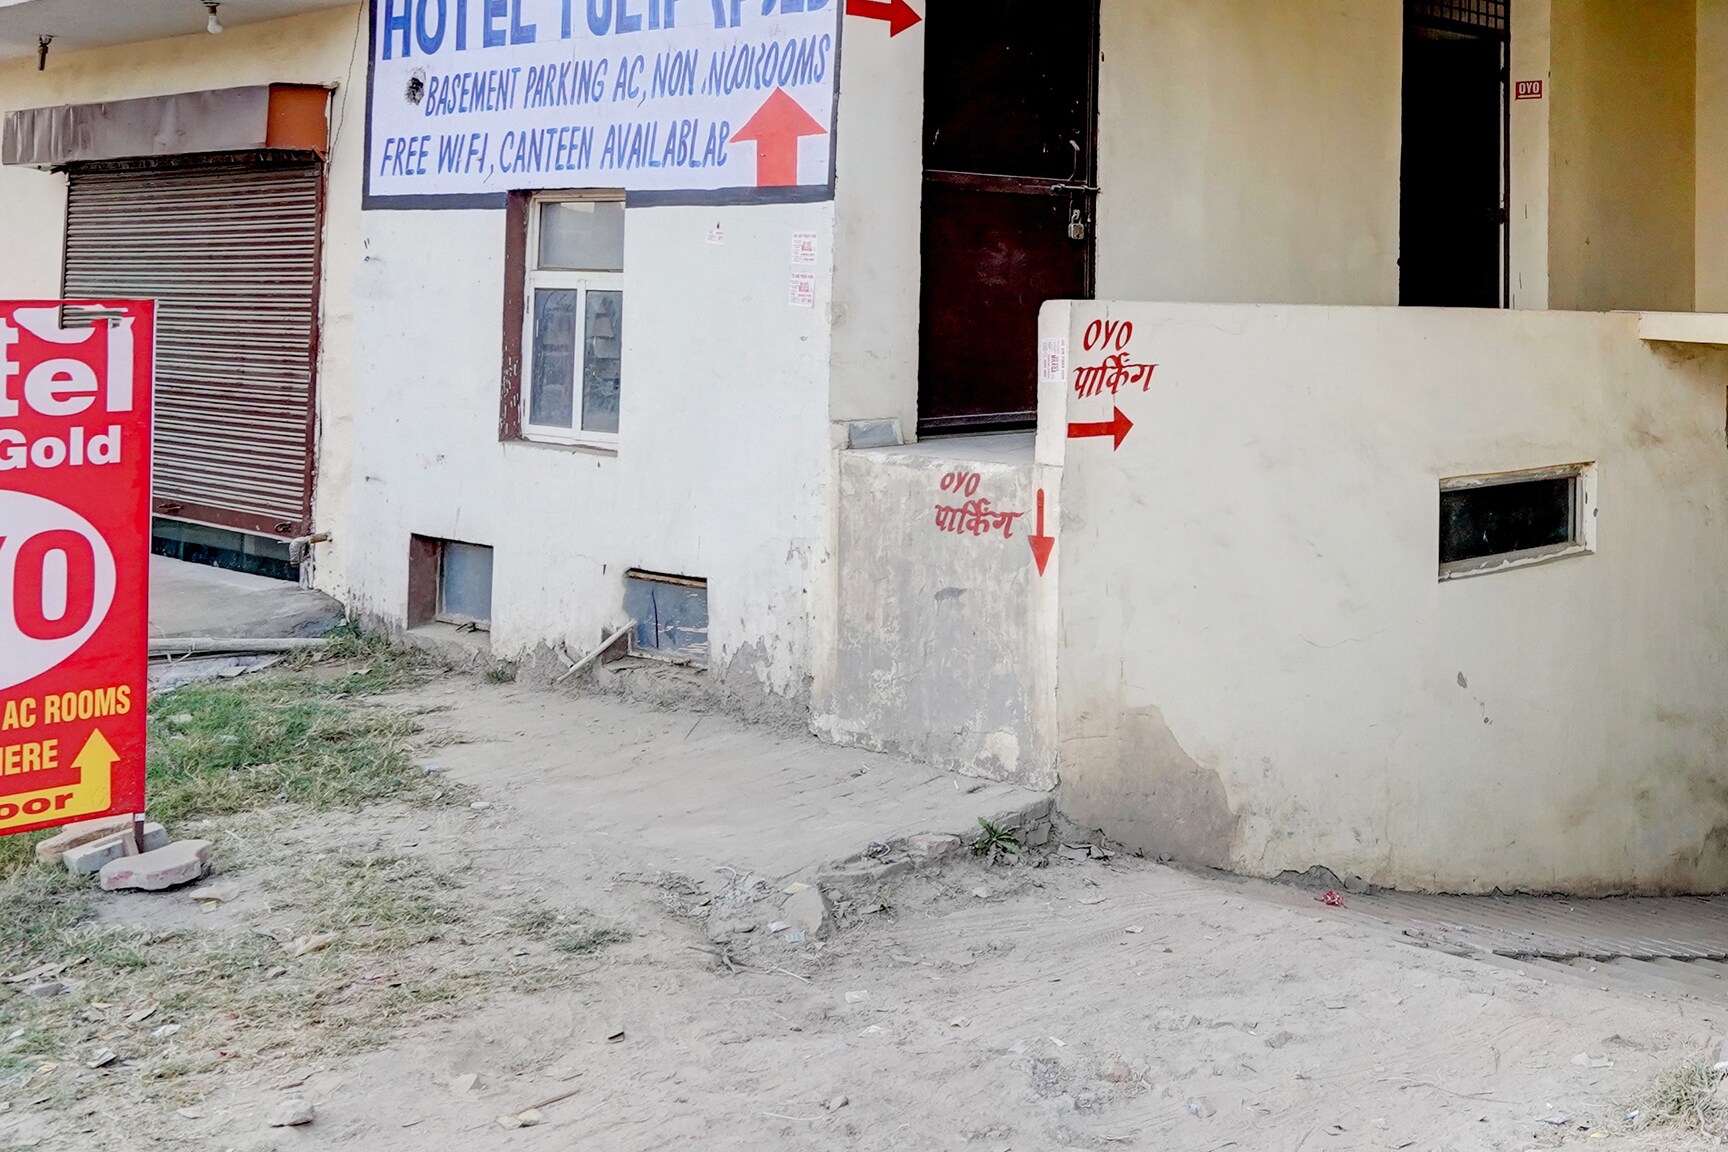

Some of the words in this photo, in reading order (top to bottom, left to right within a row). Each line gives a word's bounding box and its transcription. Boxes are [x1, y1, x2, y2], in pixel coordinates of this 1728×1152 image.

[425, 67, 521, 117] BASEMENT
[523, 58, 609, 110] PARKING
[650, 48, 699, 99] NON
[1518, 81, 1540, 95] OYO
[380, 135, 432, 177] FREE
[499, 126, 595, 174] CANTEEN
[1083, 319, 1134, 351] OYO
[0, 424, 122, 472] Gold
[940, 472, 981, 498] OYO
[2, 697, 37, 730] AC
[44, 684, 131, 725] ROOMS
[0, 738, 58, 777] ERE
